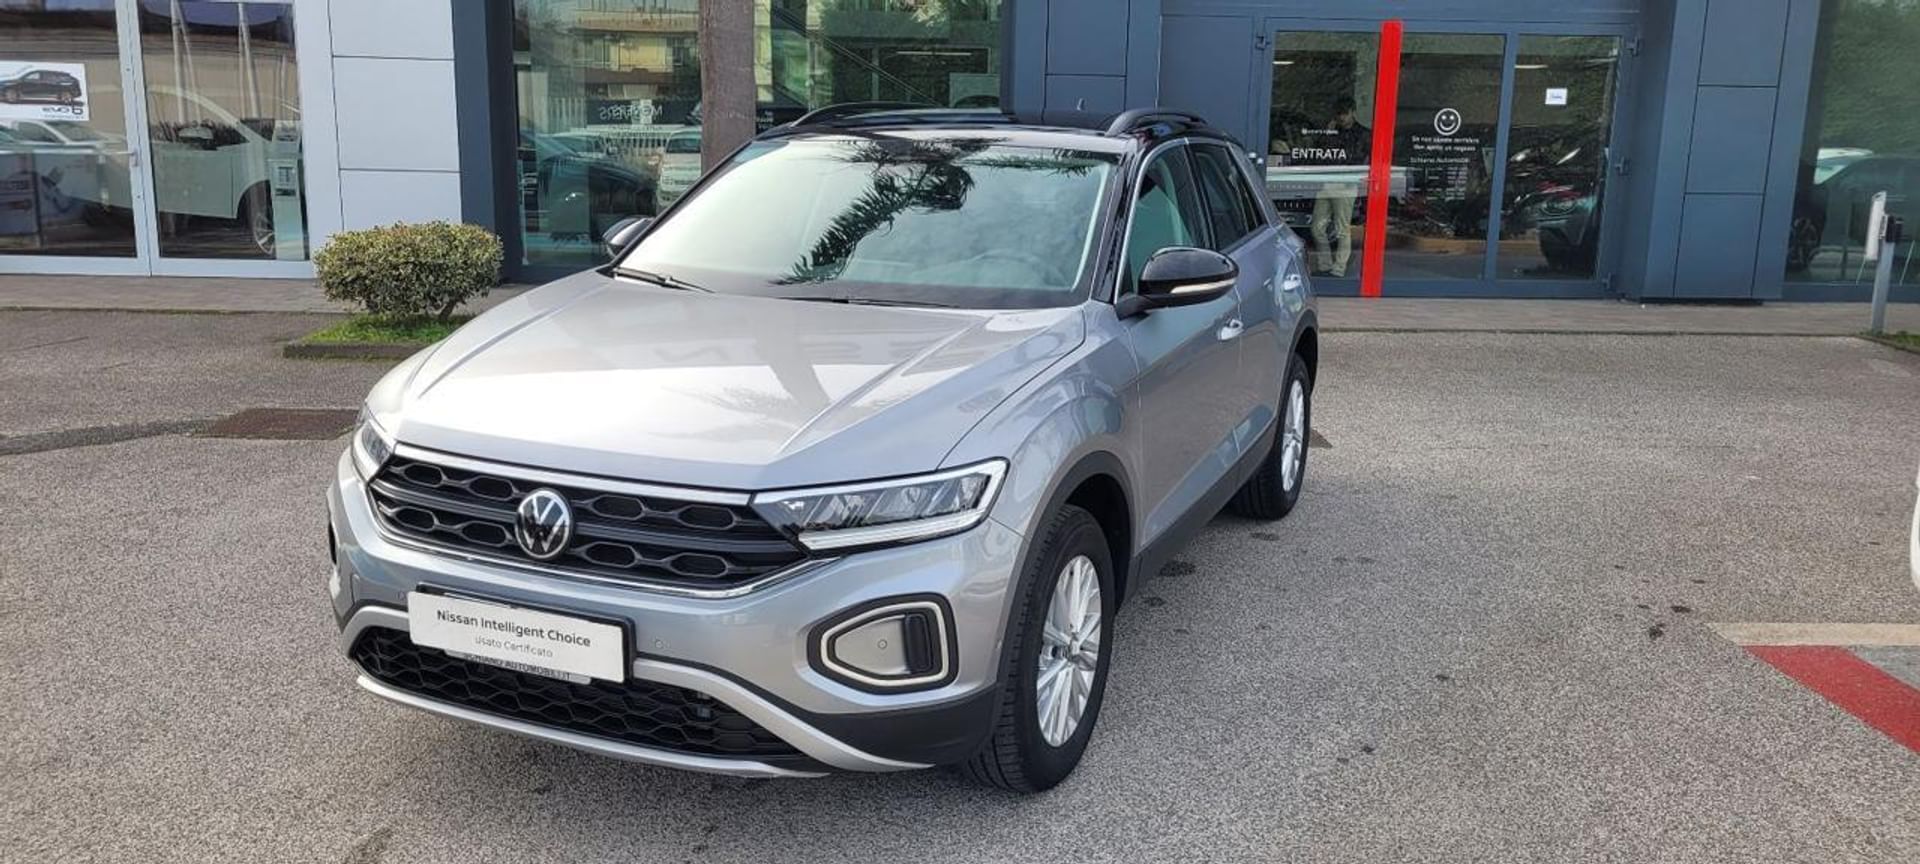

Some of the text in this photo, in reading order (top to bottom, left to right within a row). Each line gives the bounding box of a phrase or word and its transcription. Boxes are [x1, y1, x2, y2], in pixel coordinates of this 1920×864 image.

[1292, 147, 1347, 160] ENTRATA
[437, 609, 591, 648] Nissan Intelligent Choice
[475, 637, 503, 649] Usato
